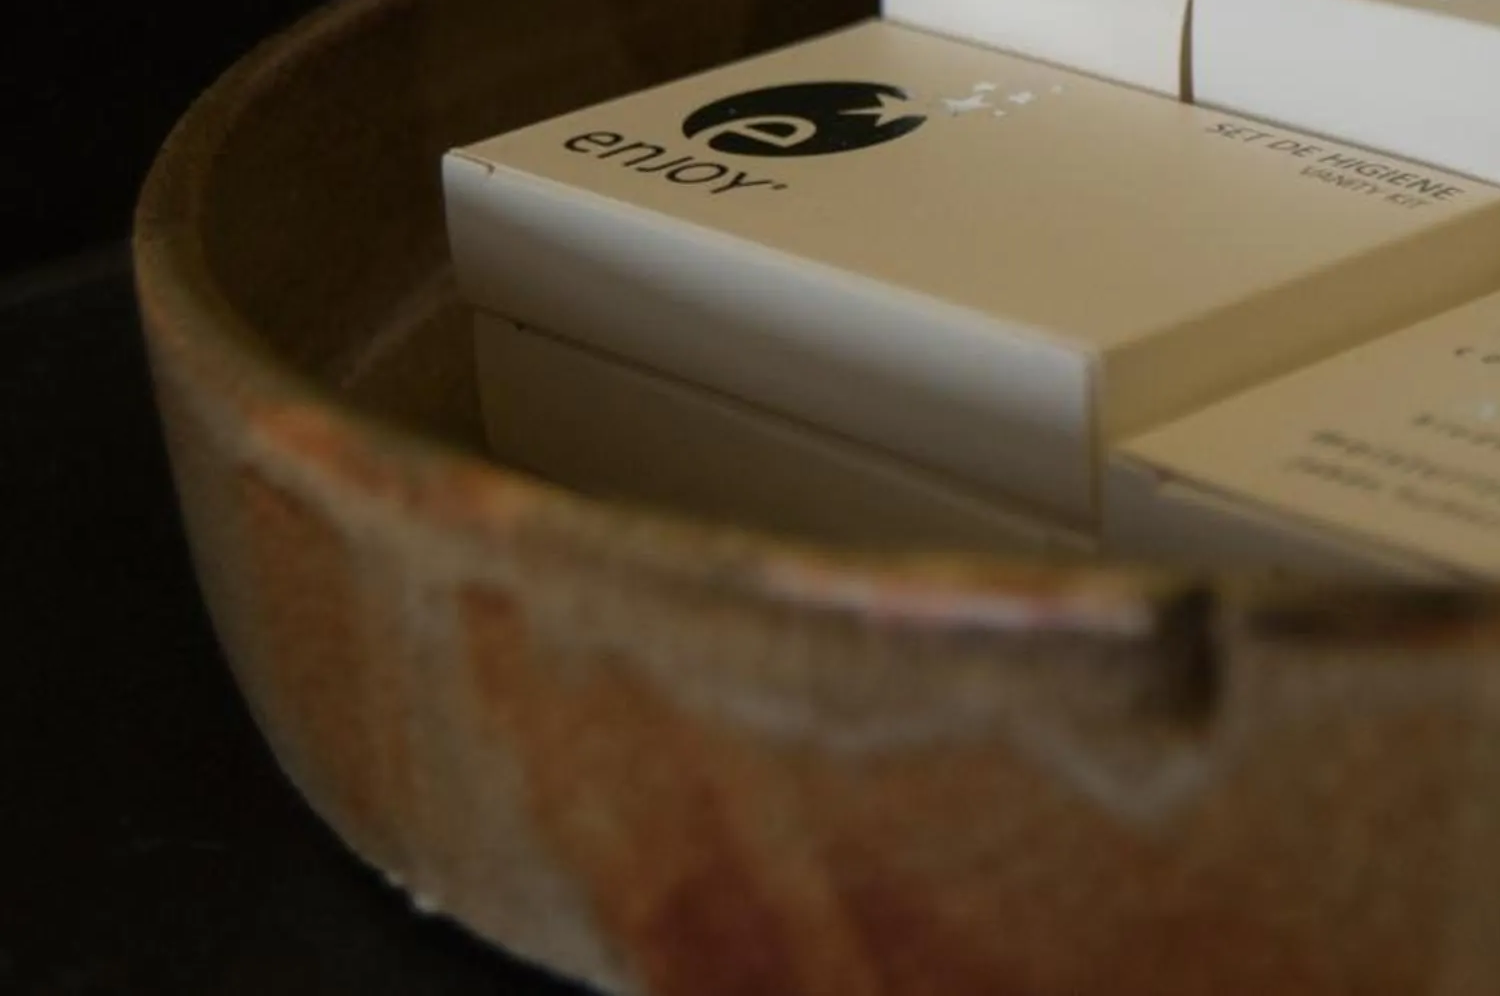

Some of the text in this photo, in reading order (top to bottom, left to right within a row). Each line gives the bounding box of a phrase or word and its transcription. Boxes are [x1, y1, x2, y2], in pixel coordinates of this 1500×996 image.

[1205, 123, 1466, 202] SET DE HIGIENE
